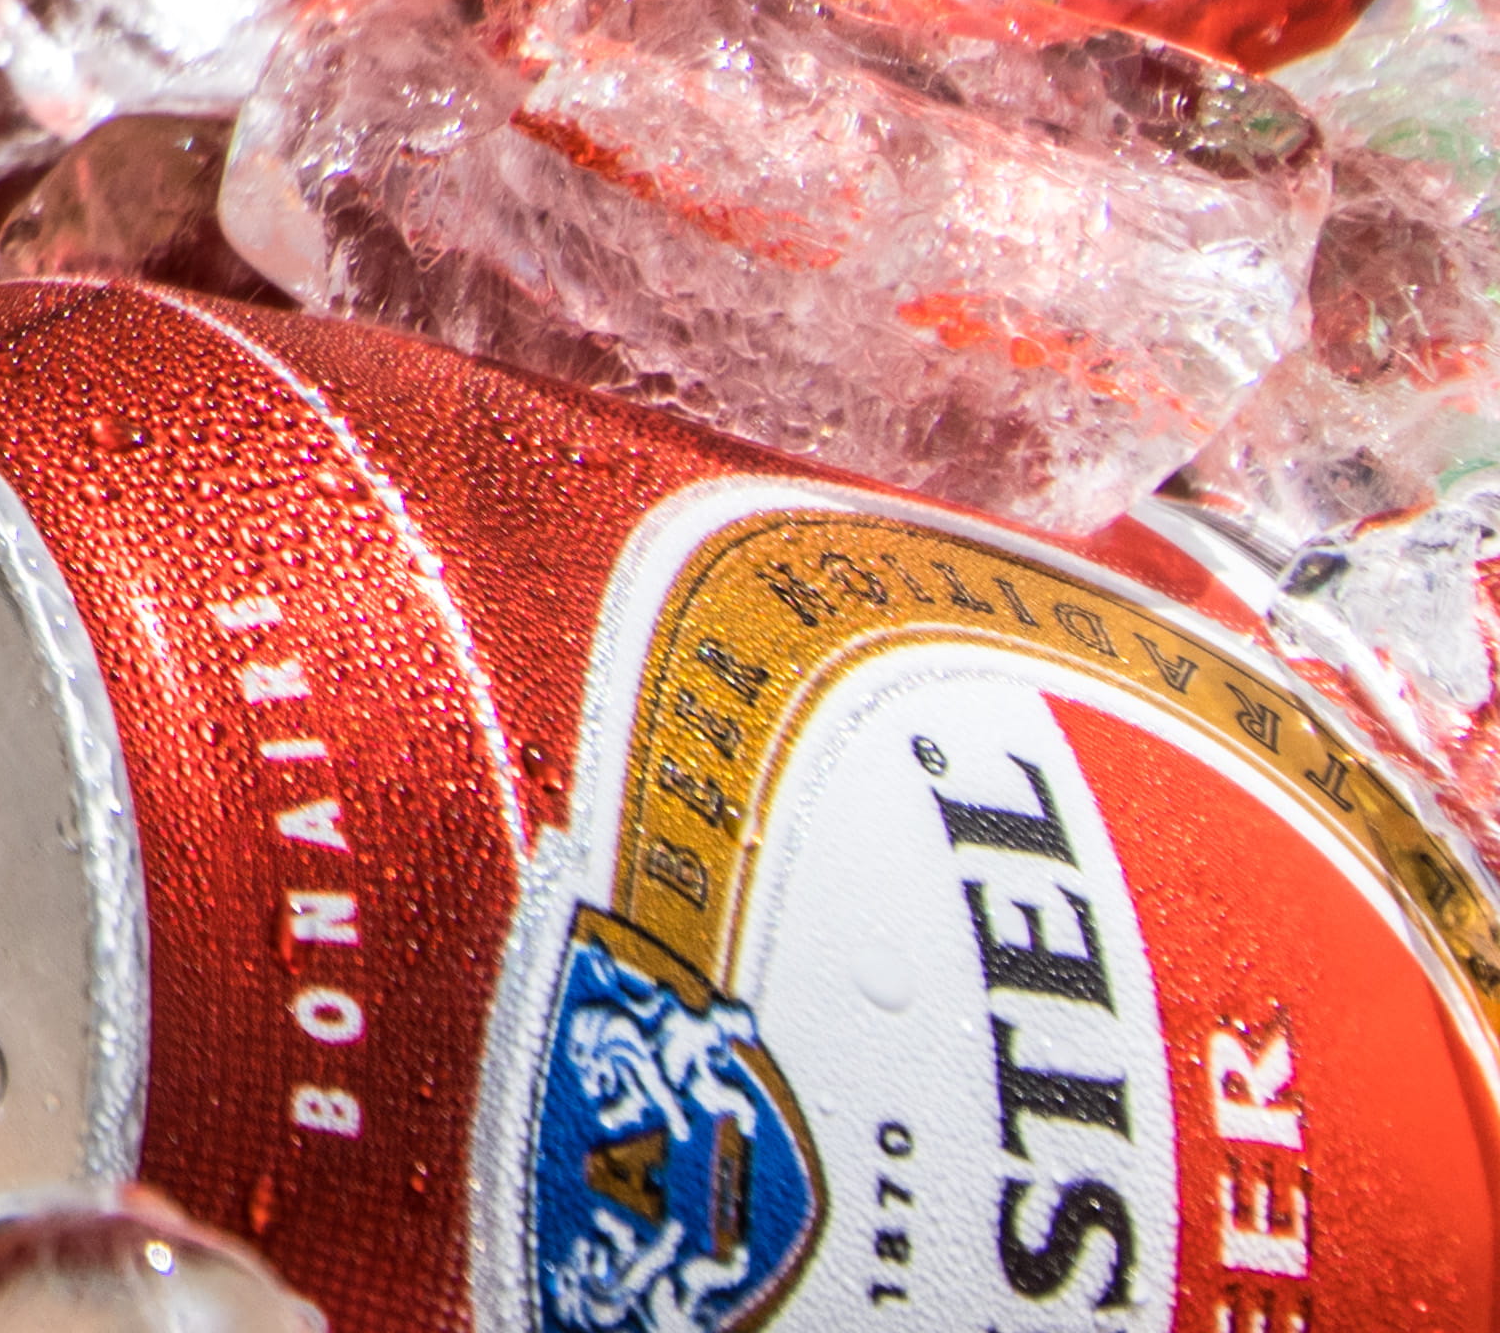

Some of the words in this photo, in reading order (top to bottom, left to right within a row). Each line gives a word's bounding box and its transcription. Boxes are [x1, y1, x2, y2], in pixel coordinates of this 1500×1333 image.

[763, 549, 1358, 812] TRADITION
[213, 594, 366, 1142] BONAIRE
[932, 750, 1142, 1321] STEL
[1208, 1027, 1313, 1333] ER
[867, 1121, 915, 1309] 1870
